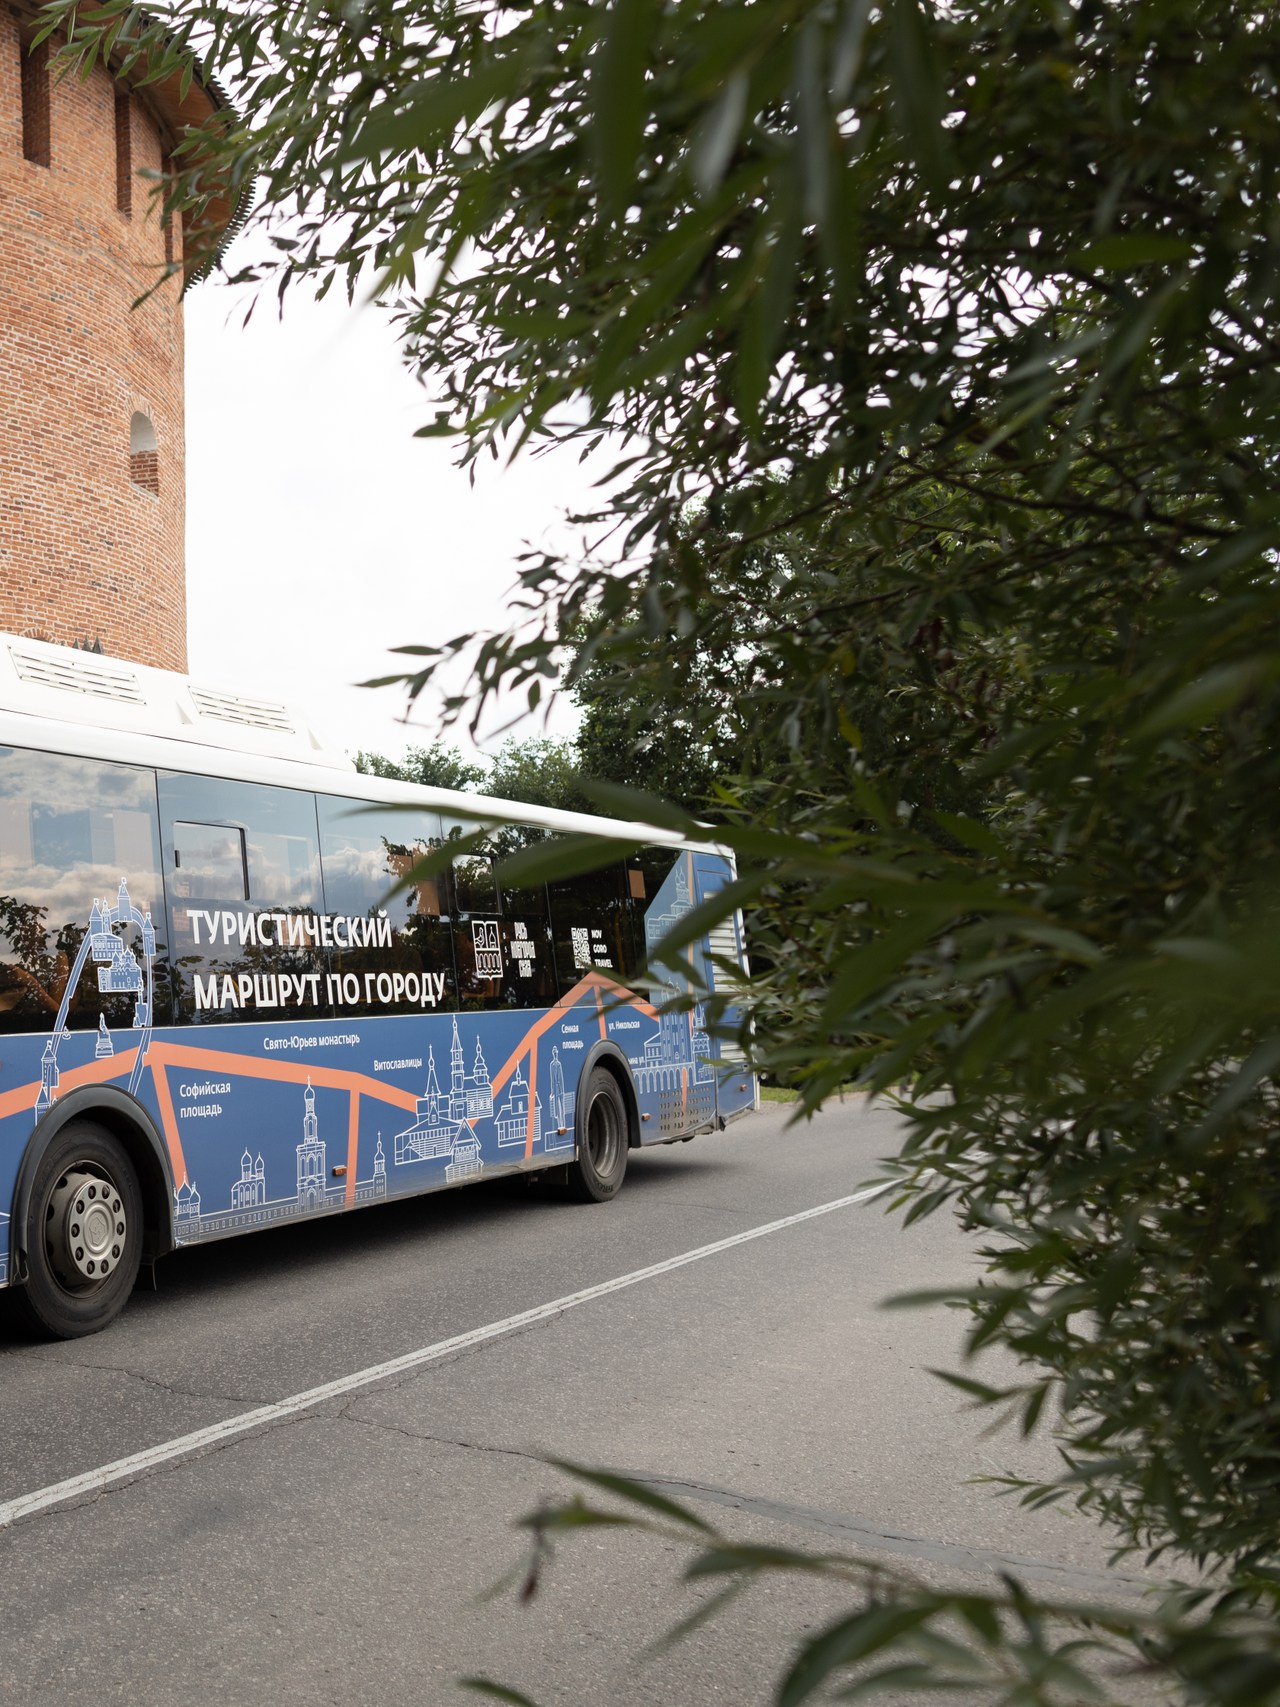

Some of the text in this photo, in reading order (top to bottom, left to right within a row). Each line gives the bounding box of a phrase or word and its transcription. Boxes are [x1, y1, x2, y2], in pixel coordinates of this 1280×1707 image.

[186, 908, 393, 948] ТУРИСТИЧЕСКИЙ
[591, 929, 602, 939] NOV
[594, 958, 614, 968] TRAVEL
[193, 972, 446, 1010] МАРШРУТ ПО ГОРОДУ
[561, 1023, 579, 1034] Сенная
[615, 1020, 640, 1030] Никольская
[263, 1033, 361, 1051] Свято-Юрьев монастырь
[562, 1040, 584, 1050] площадь
[373, 1057, 423, 1071] Витославлицы
[179, 1081, 231, 1100] Софийская
[180, 1104, 223, 1119] площадь
